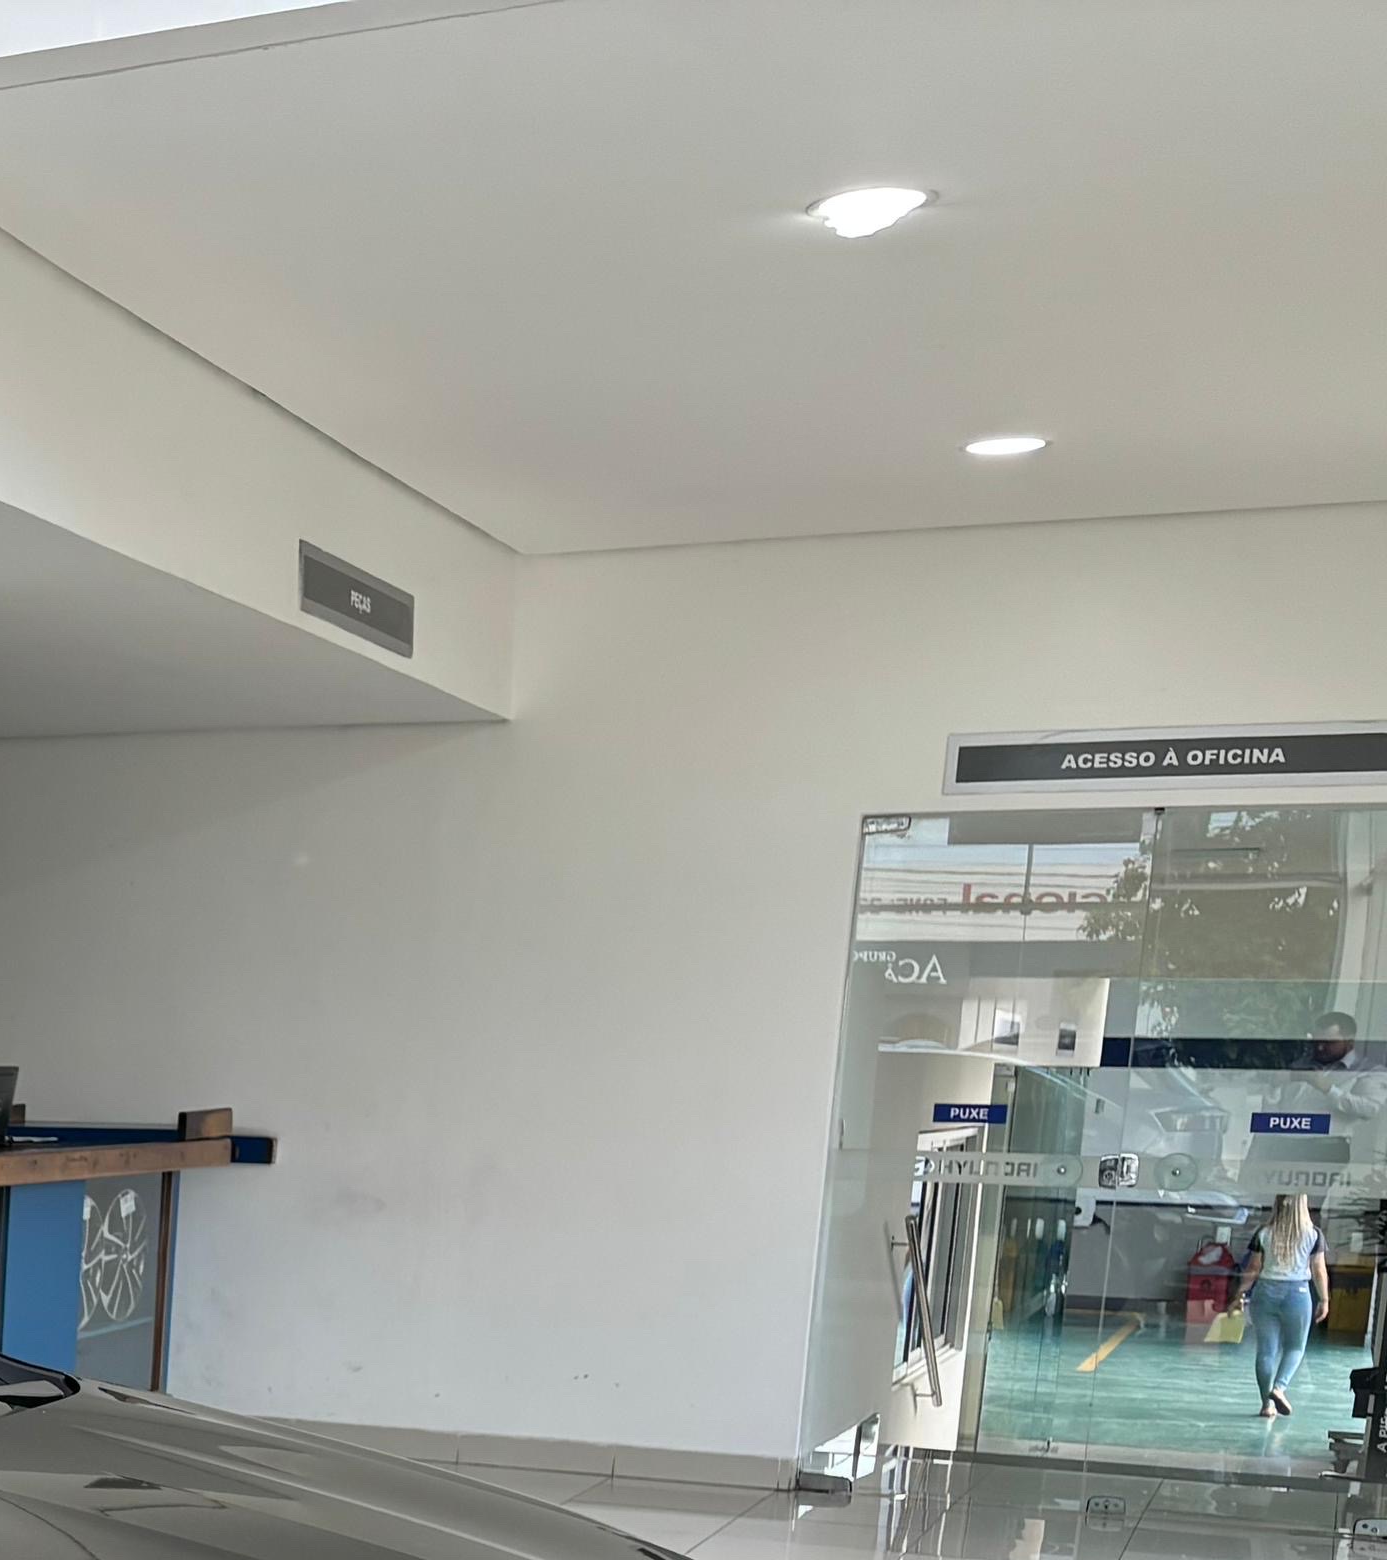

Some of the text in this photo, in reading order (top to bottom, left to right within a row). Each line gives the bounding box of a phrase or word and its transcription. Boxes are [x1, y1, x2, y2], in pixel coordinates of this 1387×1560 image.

[350, 590, 372, 614] PEÇAS
[1061, 747, 1287, 770] ACESSO À OFICINA
[949, 1107, 989, 1120] PUXE
[1269, 1117, 1312, 1130] PUXE
